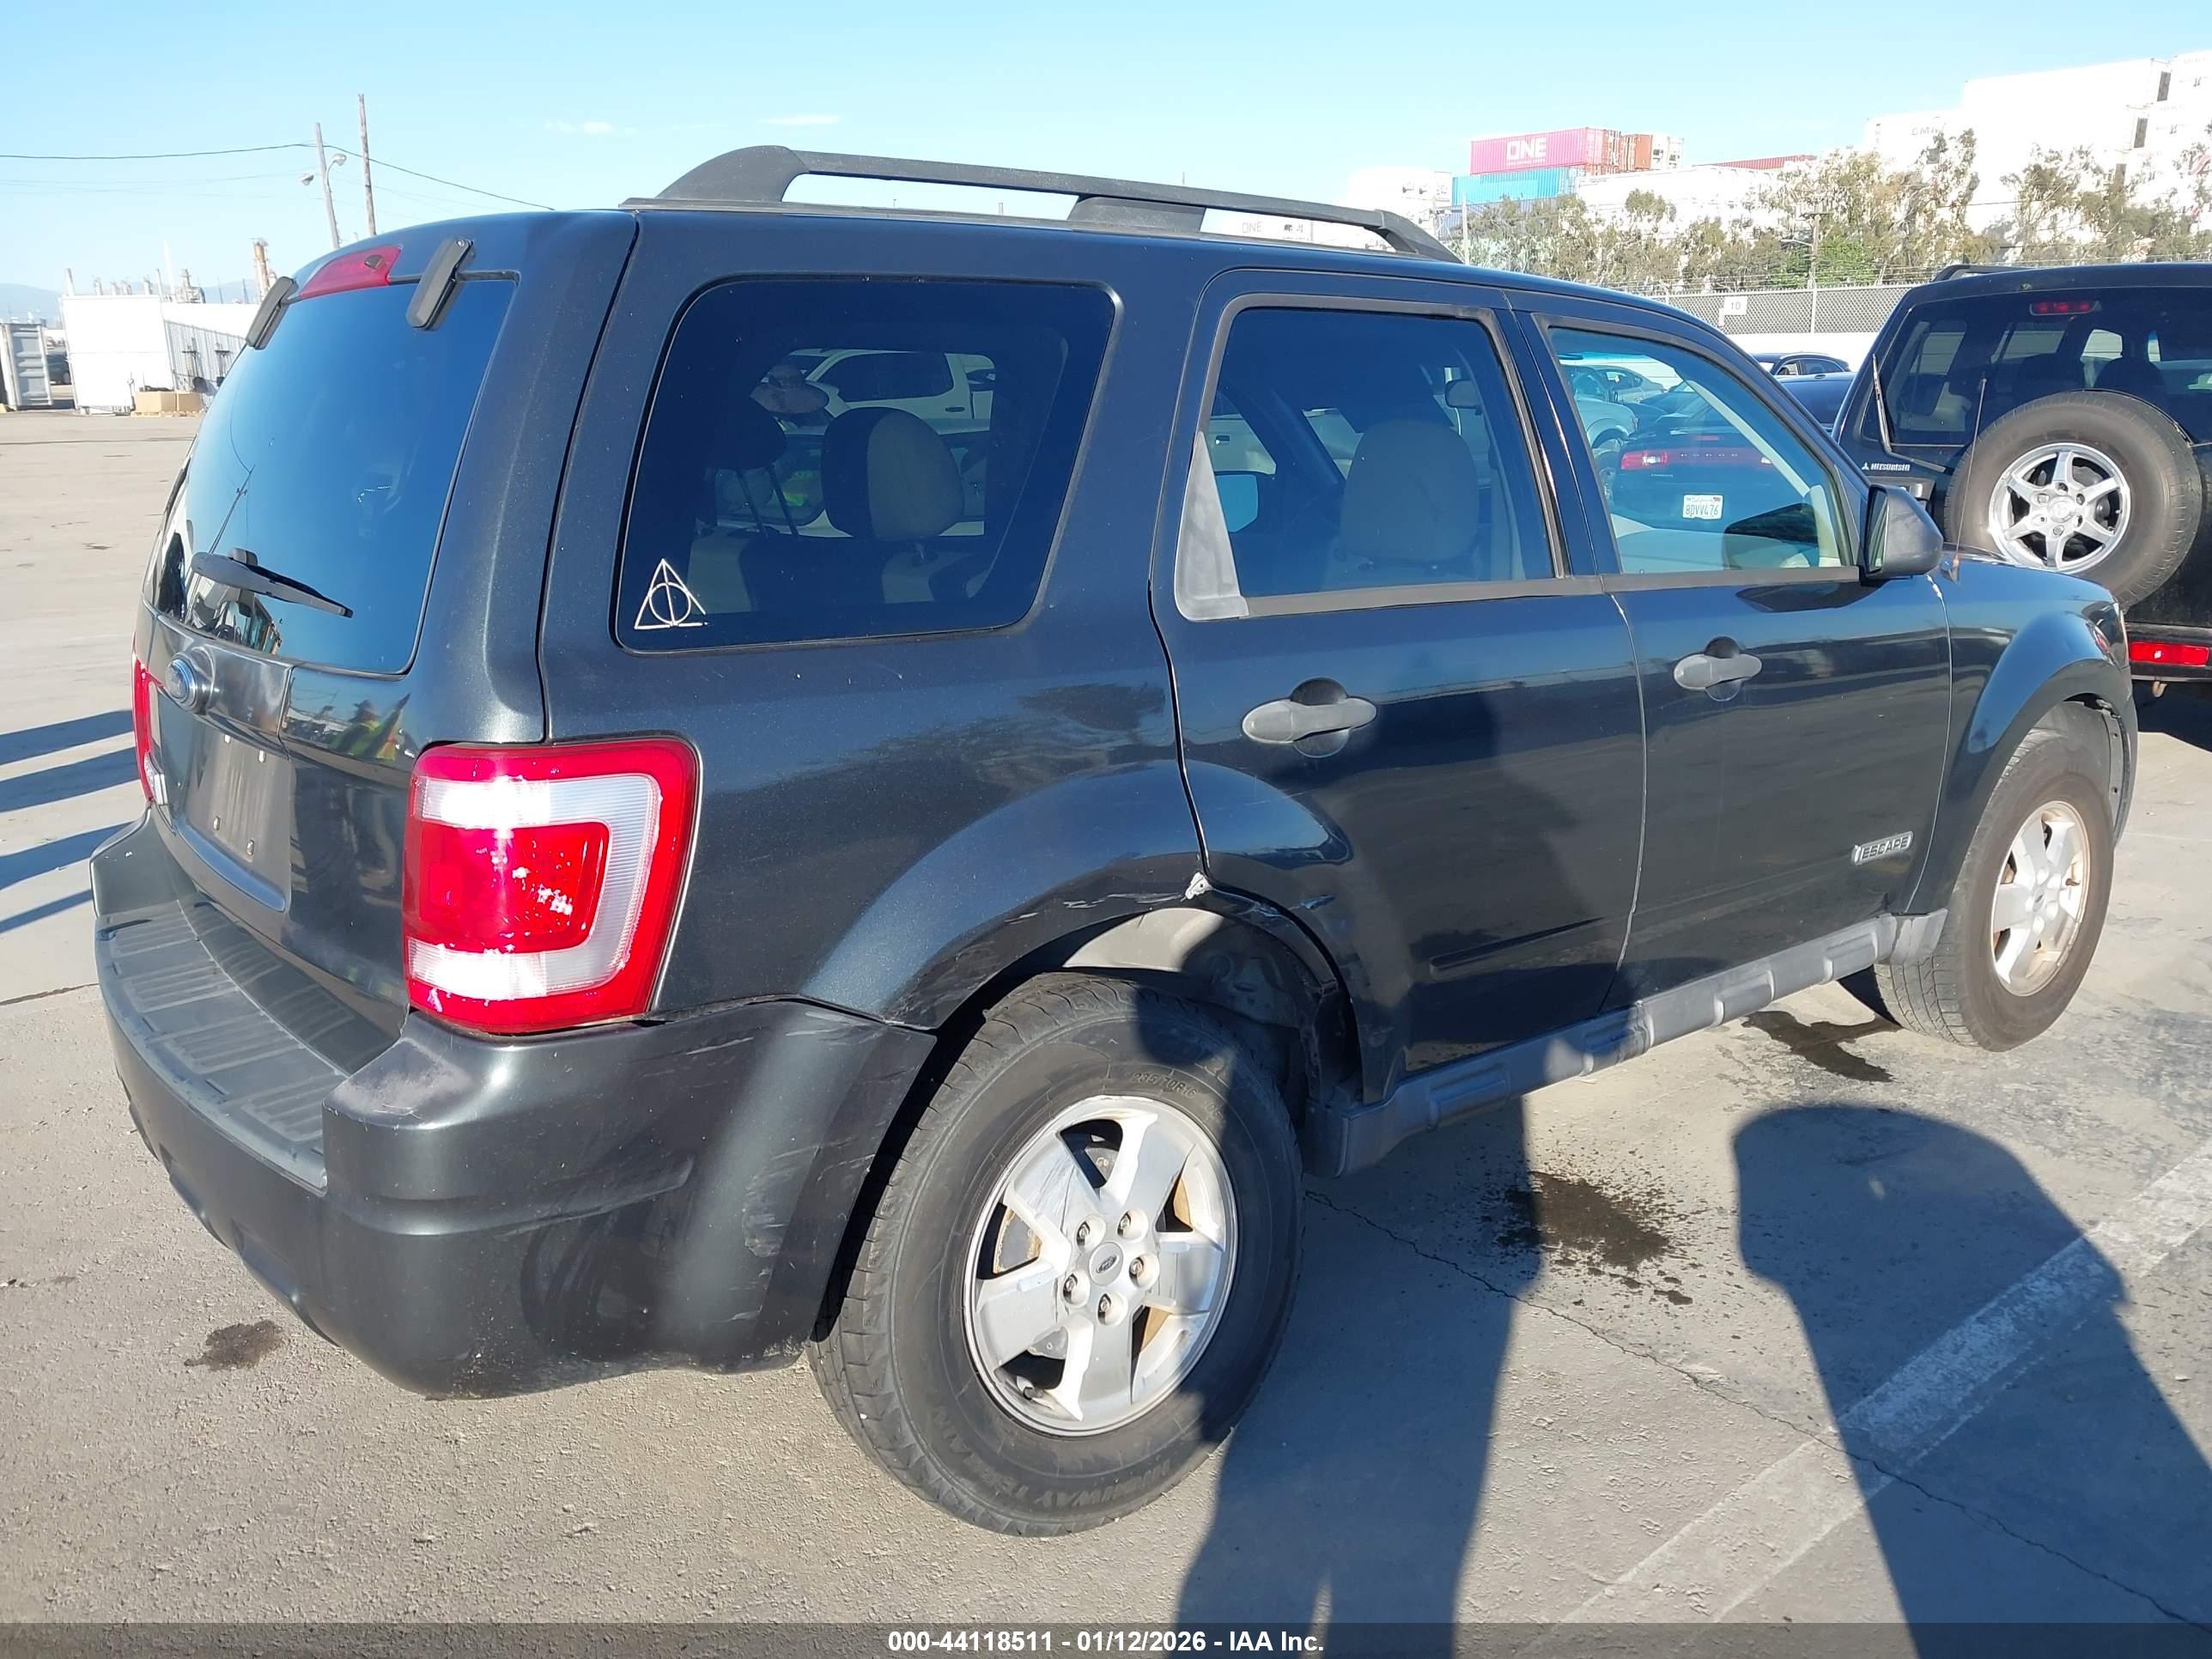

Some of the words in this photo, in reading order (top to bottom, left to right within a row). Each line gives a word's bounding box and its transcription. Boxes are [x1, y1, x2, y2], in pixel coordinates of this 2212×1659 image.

[1506, 137, 1547, 161] ONE
[1242, 221, 1262, 234] ONE
[1860, 835, 1911, 860] ESCAPE
